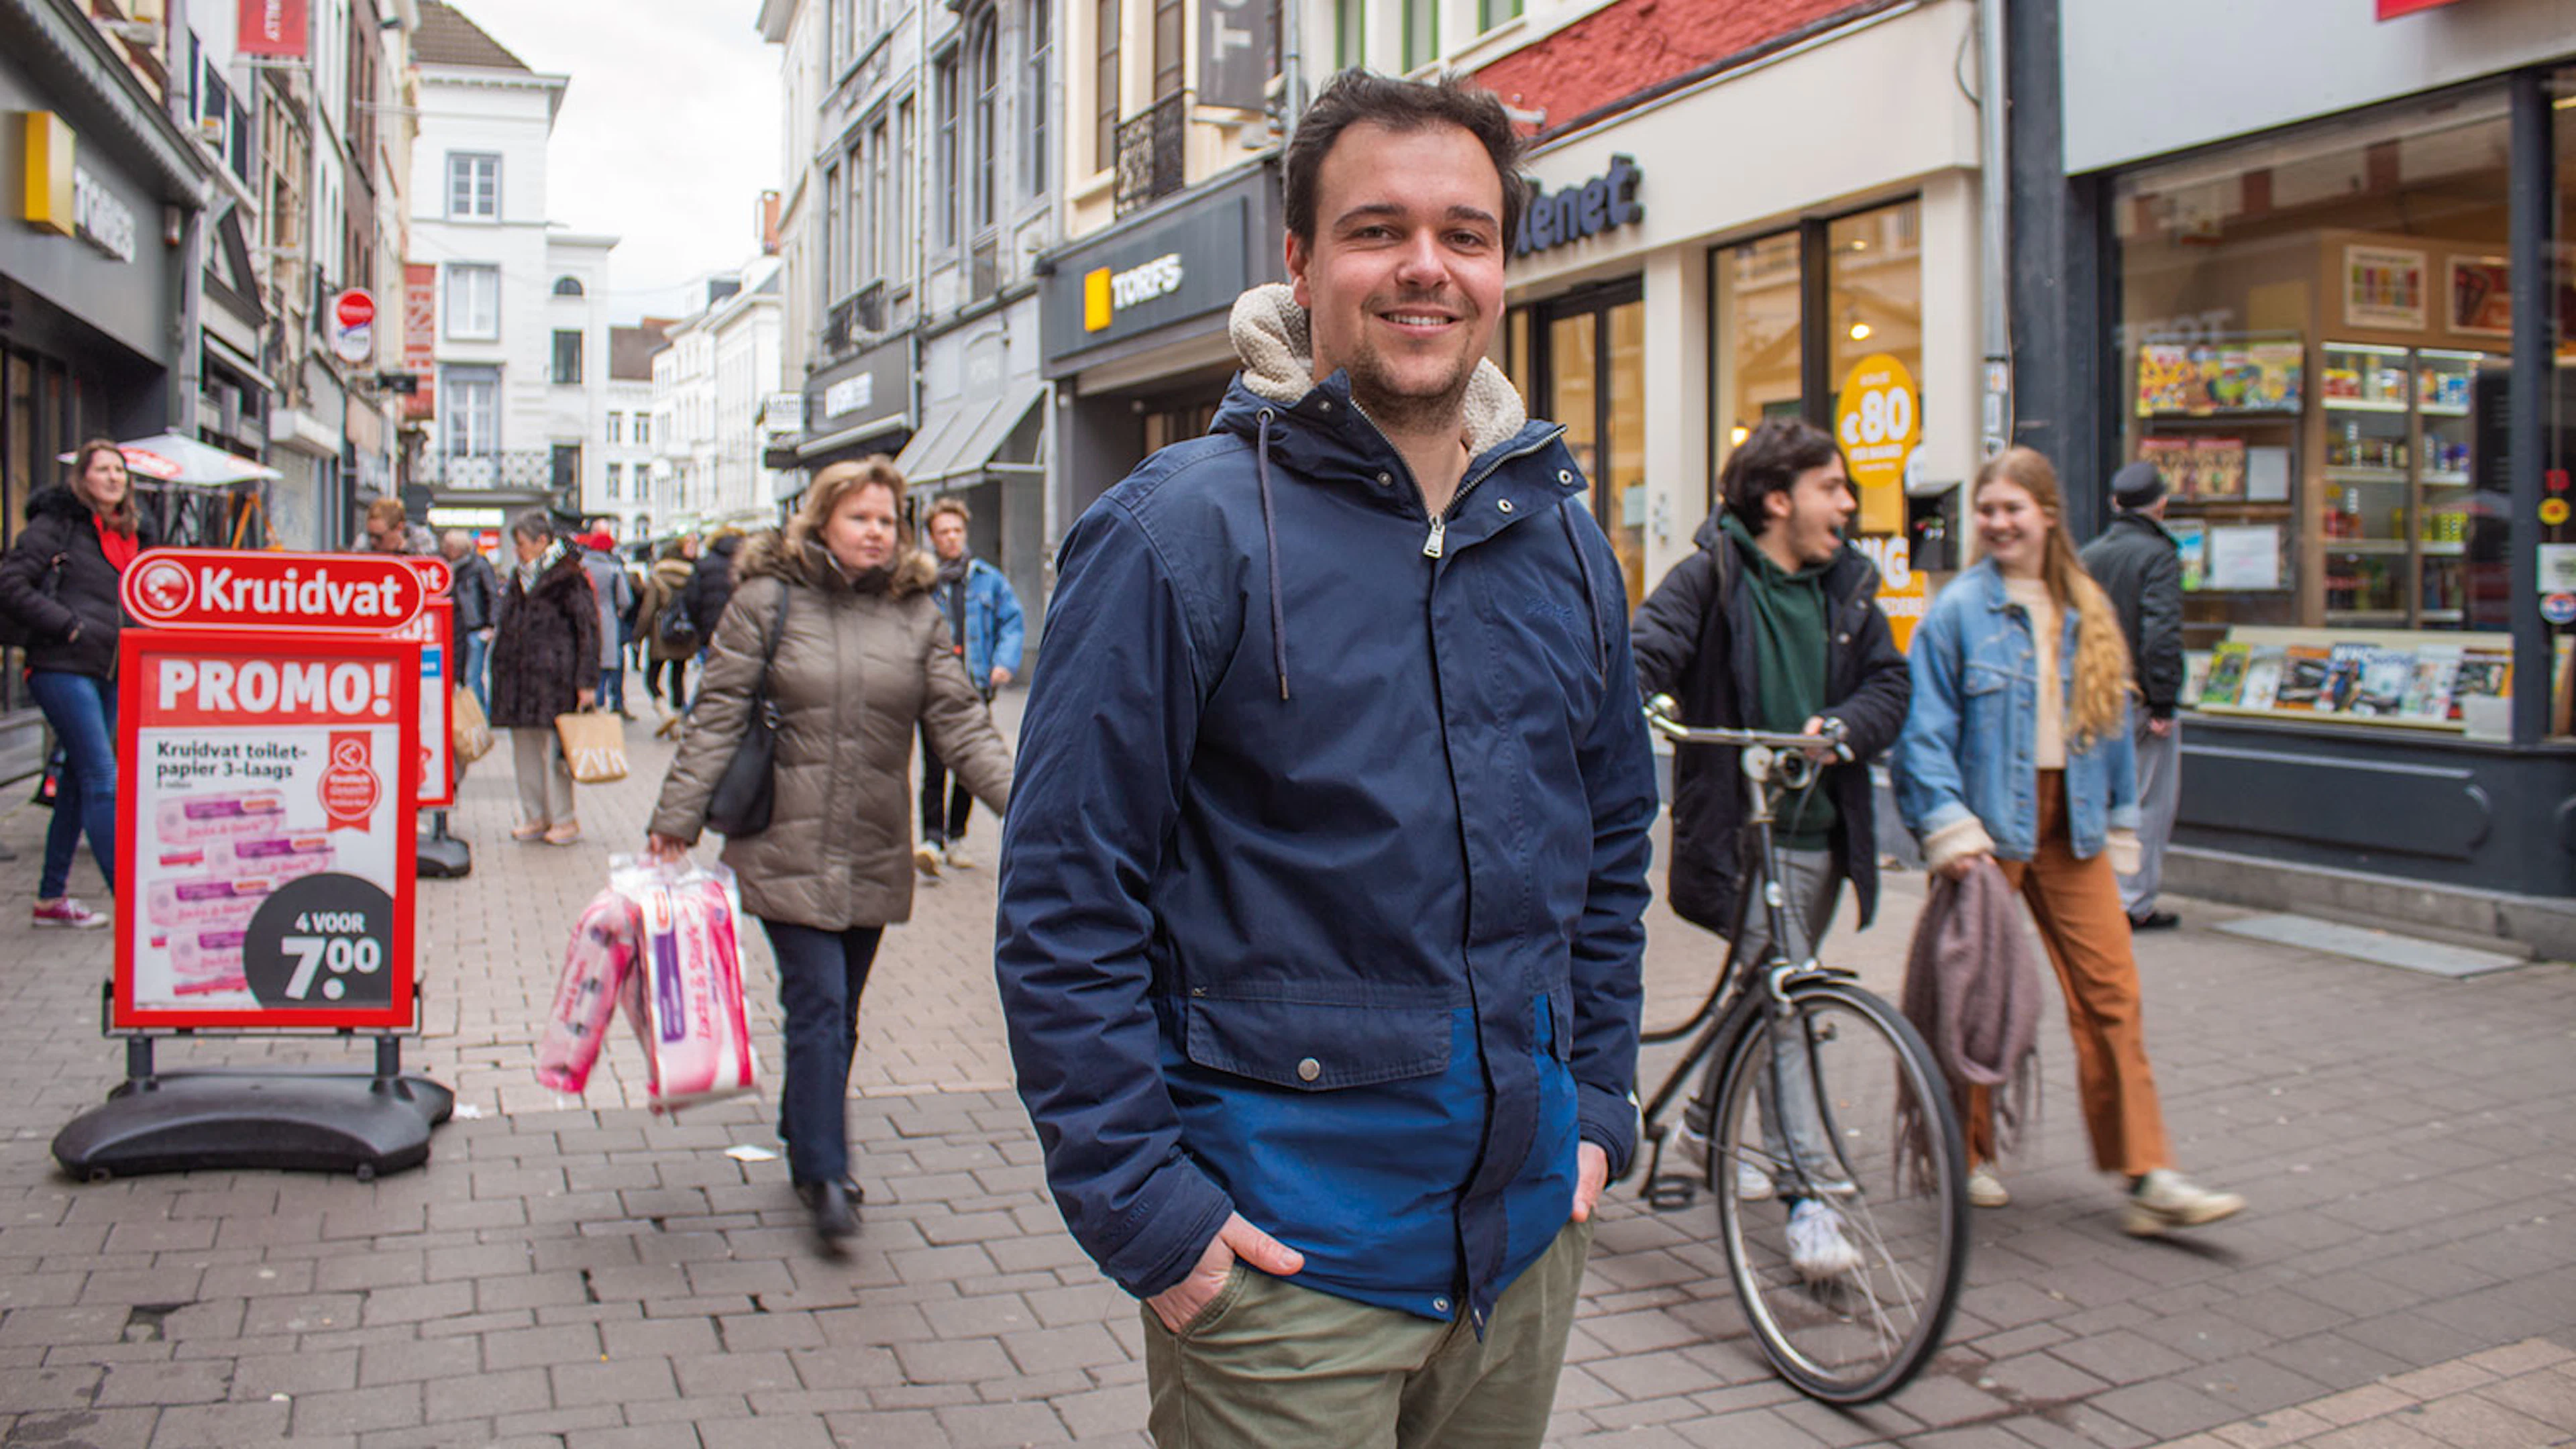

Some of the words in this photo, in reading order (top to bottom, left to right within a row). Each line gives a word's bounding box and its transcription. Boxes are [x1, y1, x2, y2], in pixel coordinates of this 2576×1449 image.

[1210, 0, 1252, 60] T
[1516, 154, 1643, 258] lenet
[1111, 253, 1183, 310] TORFS
[200, 566, 402, 617] Kruidvat
[158, 658, 392, 717] PROMO!
[156, 759, 217, 779] papier
[223, 761, 294, 782] 3-laags
[157, 740, 240, 758] Kruidvat
[246, 741, 308, 760] toilet-
[294, 912, 311, 934] 4
[311, 912, 366, 934] VOOR
